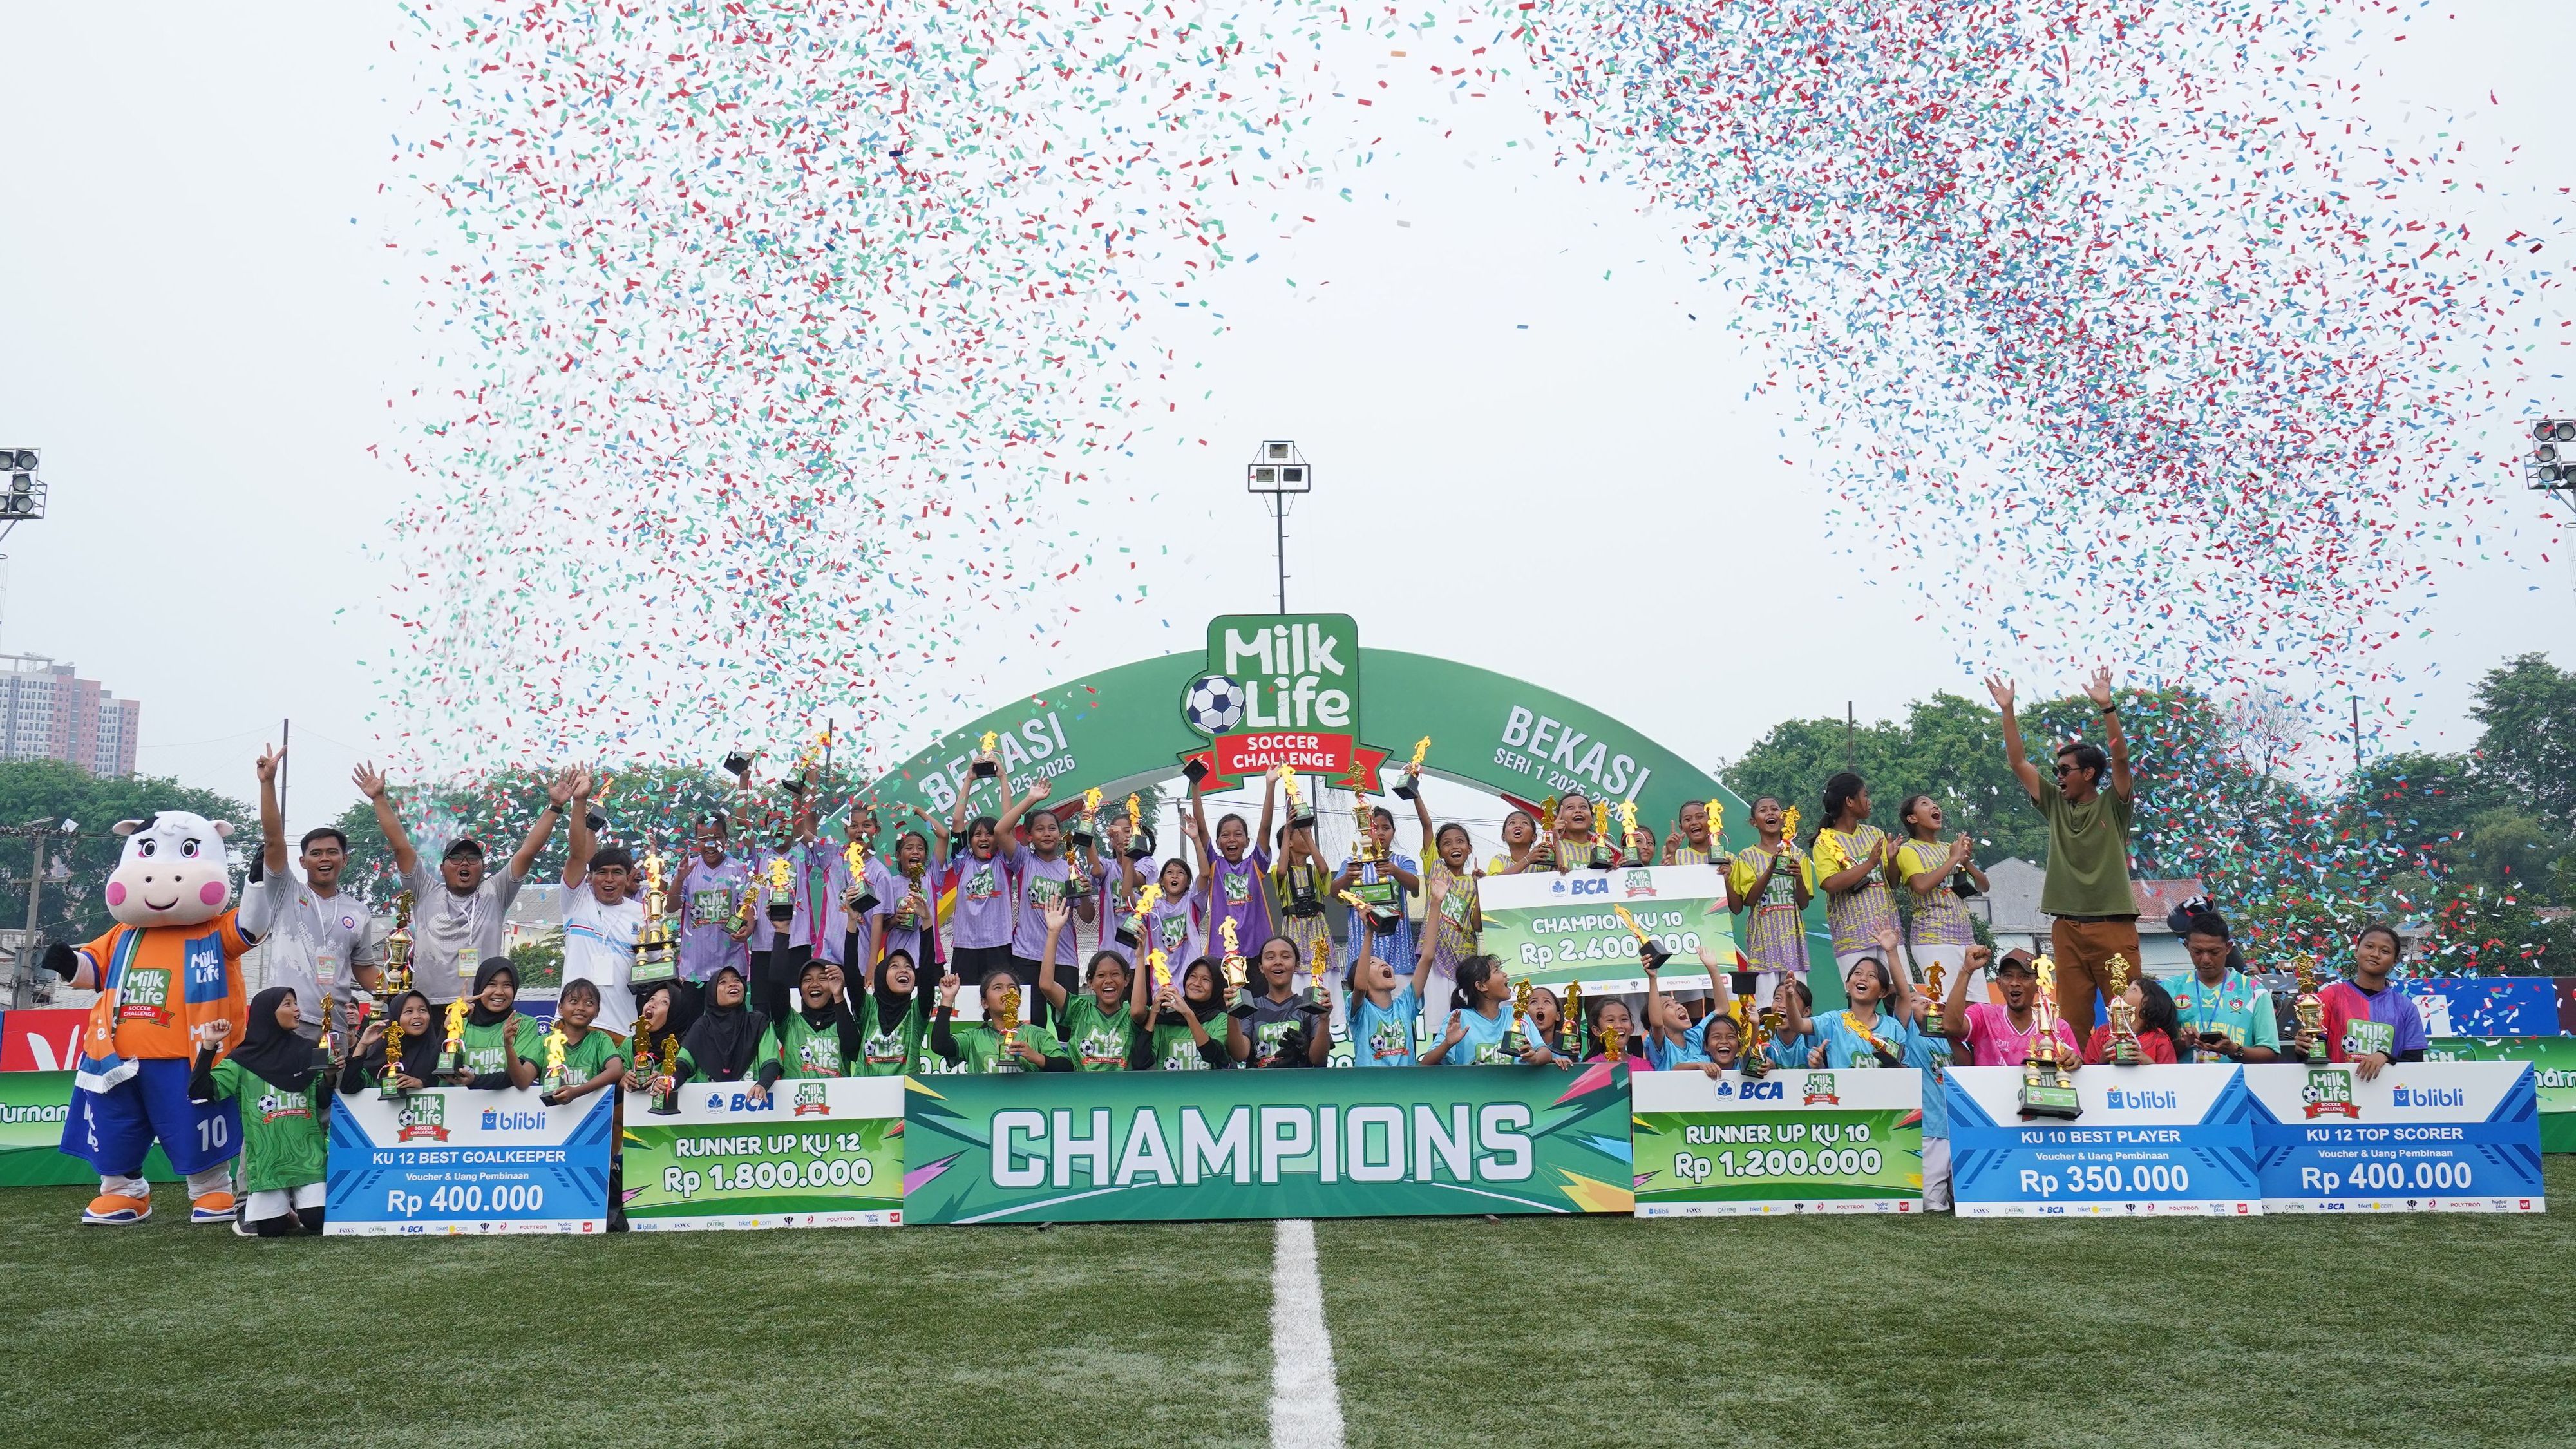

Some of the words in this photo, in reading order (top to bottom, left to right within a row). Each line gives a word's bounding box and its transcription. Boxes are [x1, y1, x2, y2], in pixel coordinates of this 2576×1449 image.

[1226, 623, 1345, 676] Milk
[1245, 676, 1350, 727] Life
[1247, 735, 1319, 750] SOCCER
[1233, 752, 1335, 768] CHALLENGE
[1501, 705, 1651, 803] BEKASI
[1493, 748, 1532, 774] SERI
[1536, 764, 1545, 780] 1
[982, 793, 993, 808] 1
[1630, 871, 1649, 880] Milk
[1571, 878, 1609, 895] BCA
[1634, 911, 1658, 932] KU
[1661, 911, 1683, 927] 10
[1520, 942, 1554, 969] Rp
[127, 971, 164, 988] Milk
[129, 987, 164, 1004] Life
[1090, 1028, 1122, 1043] Milk
[2353, 1022, 2390, 1041] Milk
[469, 1050, 504, 1066] Milk
[1095, 1044, 1123, 1057] Life
[1810, 1074, 1832, 1084] Milk
[2313, 1073, 2347, 1088] Milk
[802, 1084, 824, 1094] Milk
[1739, 1081, 1783, 1100] BCA
[1814, 1084, 1833, 1094] Life
[2319, 1086, 2349, 1102] Life
[2413, 1088, 2463, 1106] blibli
[277, 1092, 307, 1109] Life
[410, 1096, 441, 1110] Milk
[730, 1092, 774, 1112] BCA
[805, 1094, 824, 1103] Life
[2126, 1090, 2176, 1108] blibli
[415, 1110, 442, 1124] Life
[500, 1112, 546, 1130] blibli
[197, 1115, 228, 1151] 10
[1685, 1125, 1772, 1144] RUNNER
[1777, 1124, 1805, 1143] UP
[1811, 1124, 1839, 1146] KU
[1845, 1124, 1870, 1142] 10
[2022, 1132, 2043, 1143] KU
[2049, 1132, 2065, 1143] 10
[2070, 1131, 2112, 1143] BEST
[2117, 1130, 2181, 1142] PLAYER
[2307, 1130, 2329, 1141] KU
[2335, 1130, 2352, 1141] 12
[2359, 1129, 2390, 1141] TOP
[2394, 1128, 2463, 1141] SCORER
[676, 1135, 761, 1157] RUNNER
[768, 1135, 797, 1155] UP
[802, 1133, 830, 1157] KU
[836, 1133, 860, 1151] 12
[992, 1103, 1535, 1188] CHAMPIONS
[372, 1153, 393, 1164] KU
[399, 1153, 415, 1164] 12
[419, 1151, 459, 1164] BEST
[462, 1151, 566, 1164] GOALKEEPER
[2036, 1152, 2076, 1161] Voucher
[2078, 1152, 2085, 1160] &
[2088, 1152, 2113, 1162] Uang
[2116, 1151, 2169, 1160] Pembinaan
[2318, 1150, 2359, 1159] Voucher
[2361, 1150, 2369, 1158] &
[2371, 1150, 2396, 1159] Uang
[2399, 1149, 2453, 1157] Pembinaan
[1674, 1152, 1712, 1184] Rp
[1719, 1148, 1882, 1176] 1.200.000
[453, 1172, 477, 1181] Uang
[479, 1172, 529, 1180] Pembinaan
[664, 1167, 701, 1198] Rp
[708, 1159, 873, 1190] 1.800.000
[2020, 1170, 2058, 1198] Rp
[2067, 1165, 2189, 1192] 350.000
[2302, 1167, 2340, 1194] Rp
[2348, 1162, 2472, 1189] 400.000
[387, 1190, 422, 1218] Rp
[430, 1185, 544, 1212] 400.000
